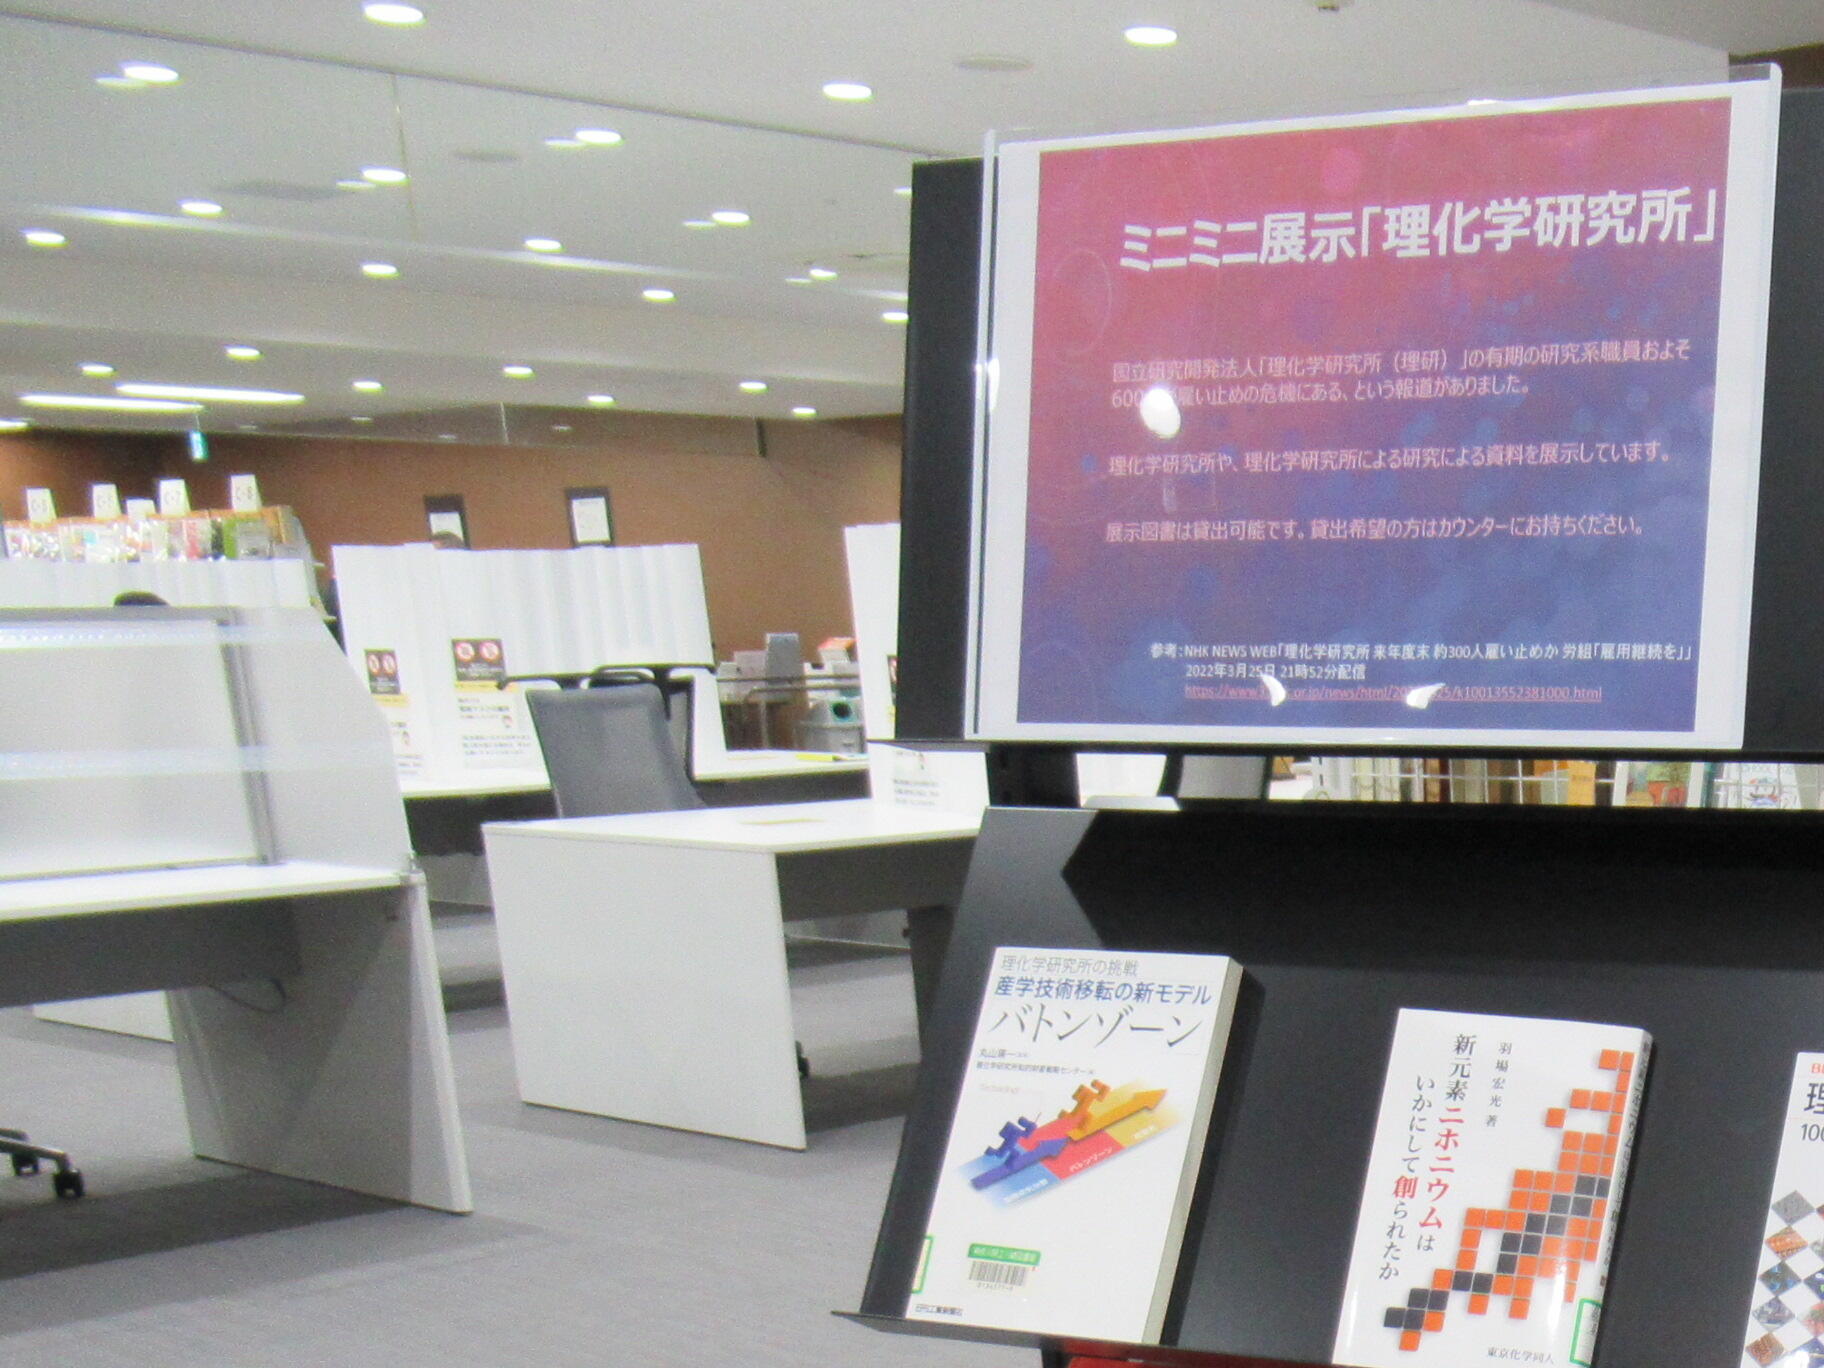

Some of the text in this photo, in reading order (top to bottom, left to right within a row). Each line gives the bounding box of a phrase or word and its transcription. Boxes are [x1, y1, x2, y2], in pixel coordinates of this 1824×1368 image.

[1118, 186, 1718, 272] ミニミニ展示「理化学研究所」
[1212, 644, 1247, 659] NEWS
[1001, 954, 1138, 978] 理化学研究所の挑戦
[994, 976, 1212, 1006] 産学技術移転の新モデル
[987, 1002, 1203, 1049] バトンゾーン
[1415, 1032, 1478, 1252] 新元素ニホニウムは
[1378, 1074, 1436, 1281] いかにして創られたか
[1486, 1346, 1556, 1366] 東京化学同人
